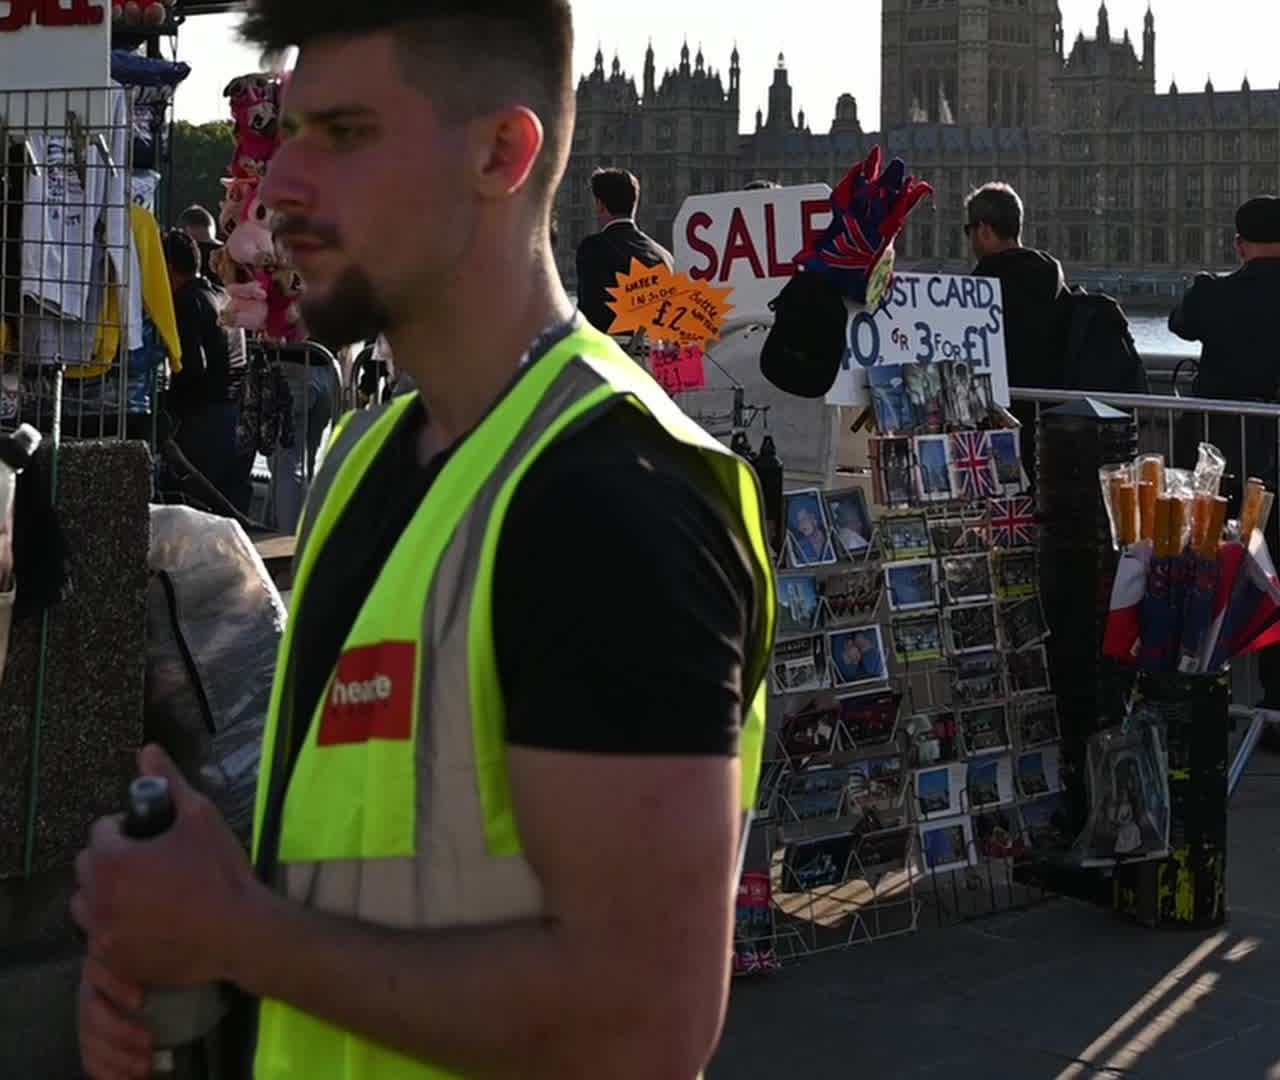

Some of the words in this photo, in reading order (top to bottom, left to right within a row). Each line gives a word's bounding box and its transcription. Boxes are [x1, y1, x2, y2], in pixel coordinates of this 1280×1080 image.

[686, 199, 833, 282] SALE
[651, 300, 687, 331] £2
[914, 321, 934, 366] 3
[934, 333, 962, 361] FOR
[962, 325, 992, 368] £1
